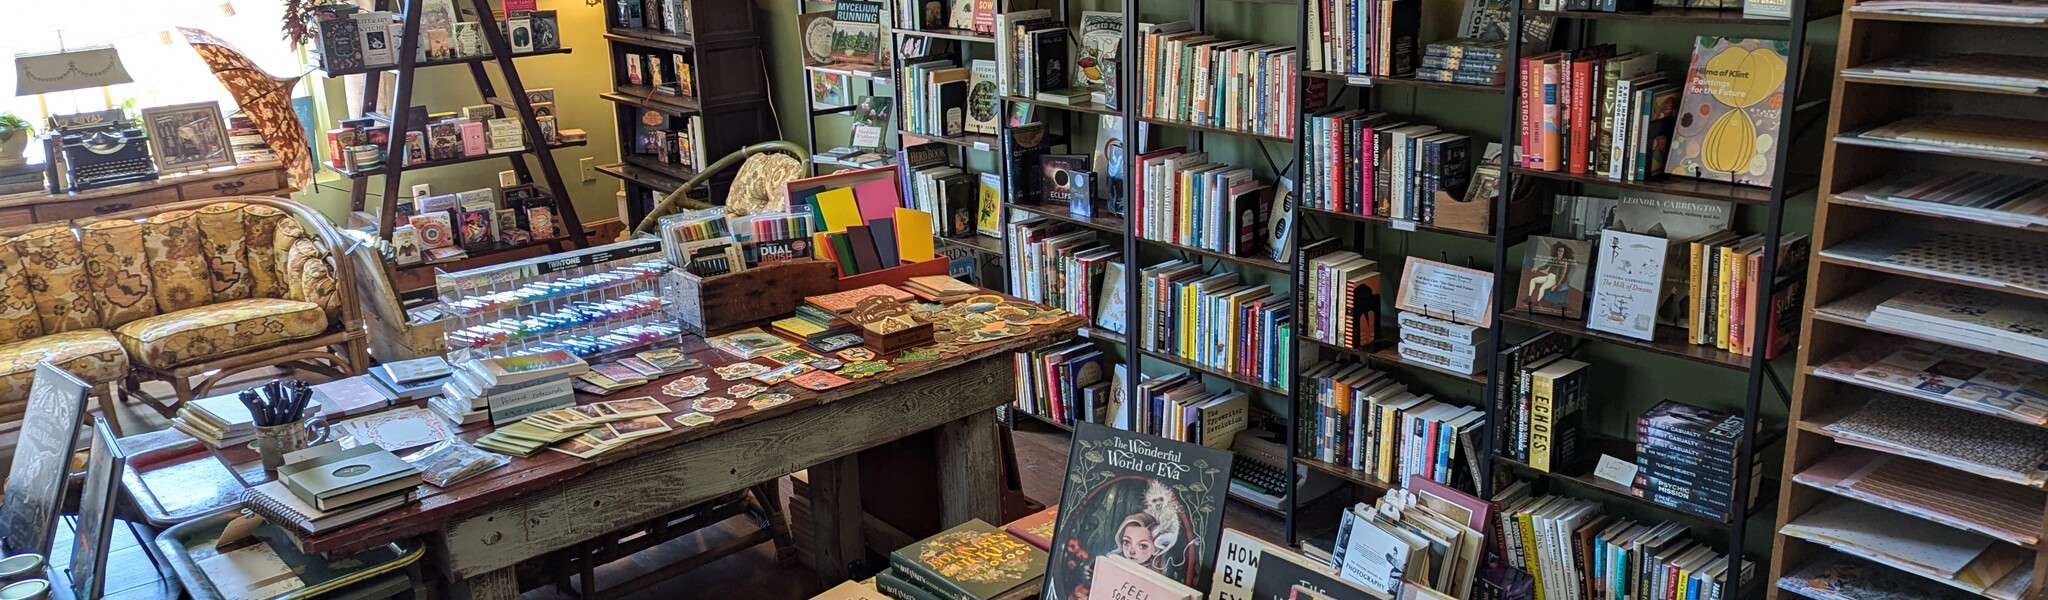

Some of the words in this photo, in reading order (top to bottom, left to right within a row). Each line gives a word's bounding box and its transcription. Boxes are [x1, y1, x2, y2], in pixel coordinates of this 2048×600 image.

[838, 2, 879, 13] MYCELIUM
[978, 1, 993, 10] SOW
[837, 12, 878, 23] RUNNING
[1086, 23, 1108, 32] WICKED
[1696, 68, 1718, 76] Hilma
[1730, 70, 1750, 79] Klint
[1694, 78, 1730, 87] Paintings
[1690, 86, 1703, 94] for
[1718, 89, 1746, 98] Future
[73, 114, 104, 124] ROYAL
[910, 151, 928, 163] HERB
[928, 148, 946, 158] BOOK
[1162, 186, 1171, 214] Joyful
[1623, 197, 1660, 207] LEONORA
[1663, 201, 1722, 213] CARRINGTON
[760, 244, 792, 256] DUAL
[761, 252, 792, 262] BRUSH
[548, 256, 581, 268] TWINTONE
[1612, 280, 1625, 288] Milk
[1625, 283, 1632, 291] of
[1632, 285, 1653, 294] Dreams
[1625, 277, 1653, 286] CARRINGTON
[1207, 410, 1218, 418] The
[1207, 407, 1243, 426] Typewriter
[1207, 416, 1242, 434] Revolution
[1534, 395, 1549, 455] ECHOES
[1671, 425, 1700, 438] CASUALTY
[1709, 414, 1743, 436] FIRST
[1668, 433, 1698, 446] CASUALTY
[1114, 436, 1127, 450] The
[1129, 438, 1182, 463] Wonderful
[1669, 443, 1699, 456] CASUALTY
[1108, 450, 1143, 472] World
[1145, 462, 1156, 472] of
[1157, 462, 1190, 480] Eva
[1656, 462, 1672, 470] FLYING
[1673, 467, 1696, 477] OBJECTS
[1658, 480, 1690, 494] PSYCHIC
[1658, 486, 1689, 500] MISSION
[1494, 503, 1502, 527] GEENA
[1496, 528, 1505, 549] DAVIS
[1512, 521, 1520, 548] CHOOSING
[1520, 521, 1529, 543] DON'T
[946, 537, 970, 549] THE
[1535, 530, 1544, 550] class
[938, 540, 1025, 577] STICKER
[1227, 542, 1258, 568] HOW
[1523, 546, 1532, 562] CALL
[956, 546, 1032, 582] ANTHOLOGY
[1223, 565, 1243, 588] BE
[1346, 563, 1385, 590] PHOTOGRAPHY
